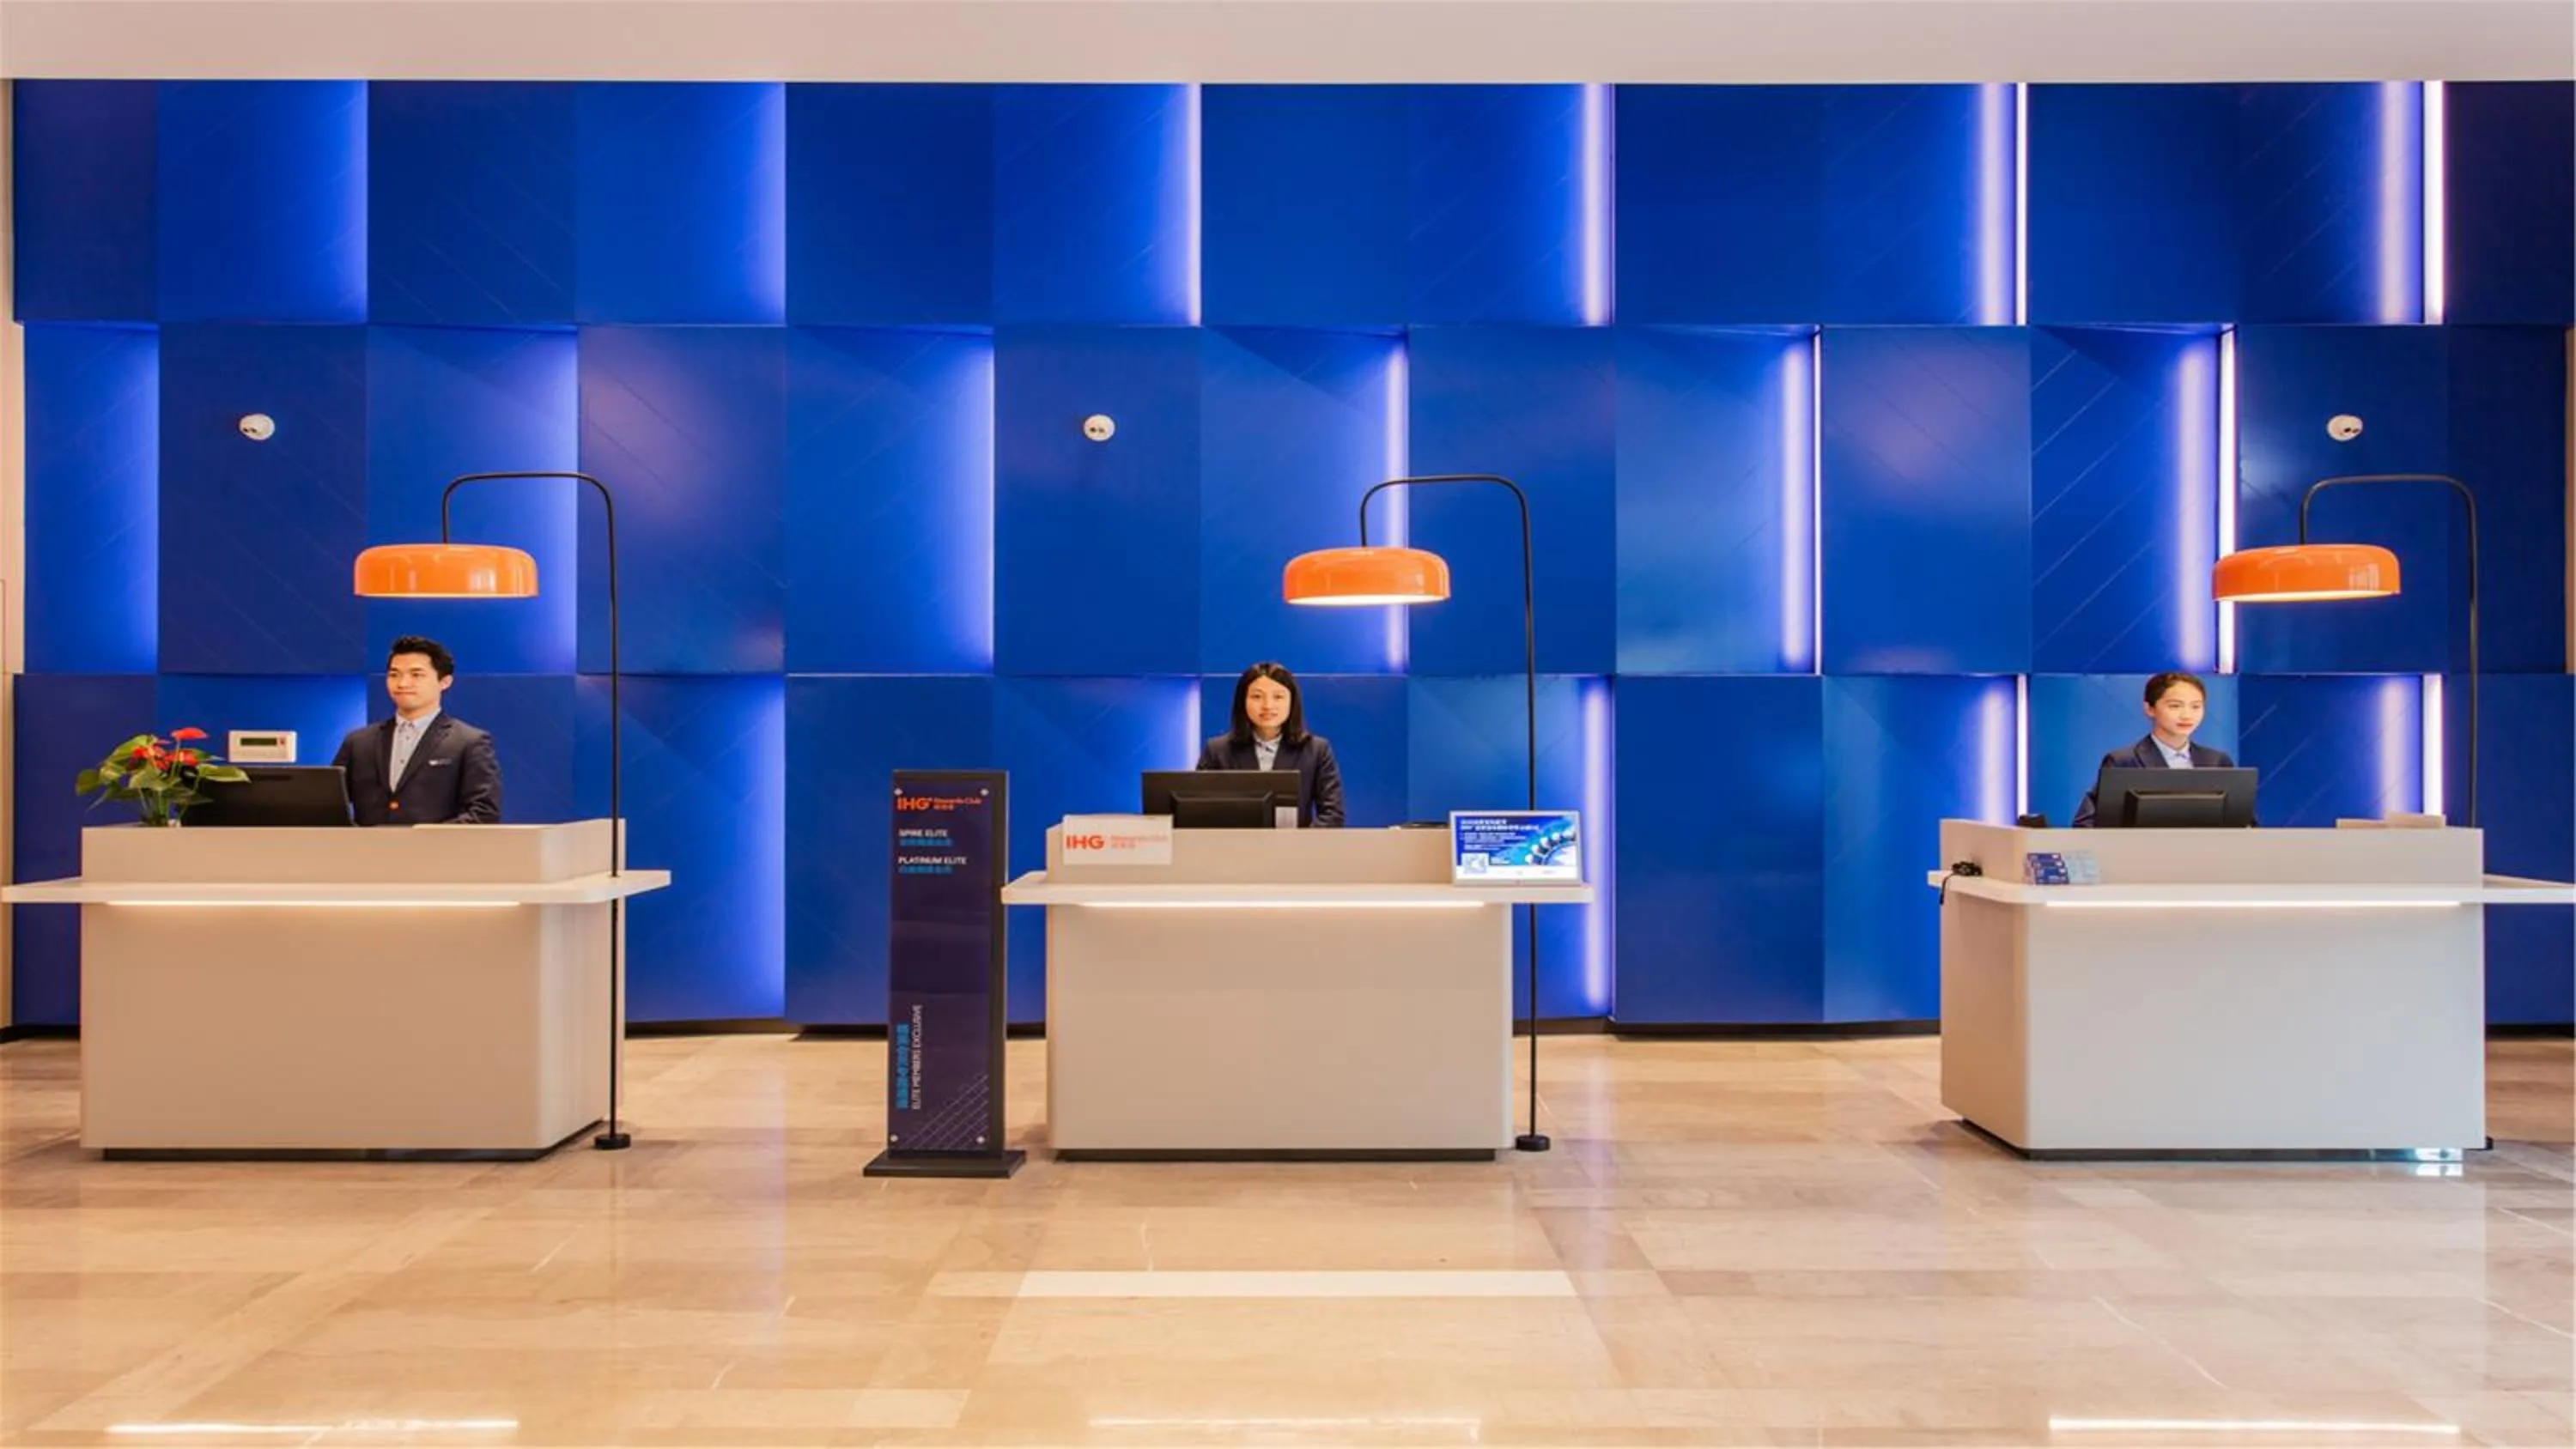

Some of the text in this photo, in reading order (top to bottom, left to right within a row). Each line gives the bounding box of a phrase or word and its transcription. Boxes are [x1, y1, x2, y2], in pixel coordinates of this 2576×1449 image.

[897, 797, 929, 810] IHG
[925, 829, 948, 838] ELITE
[1066, 834, 1104, 850] IHG
[944, 857, 967, 865] ELITE
